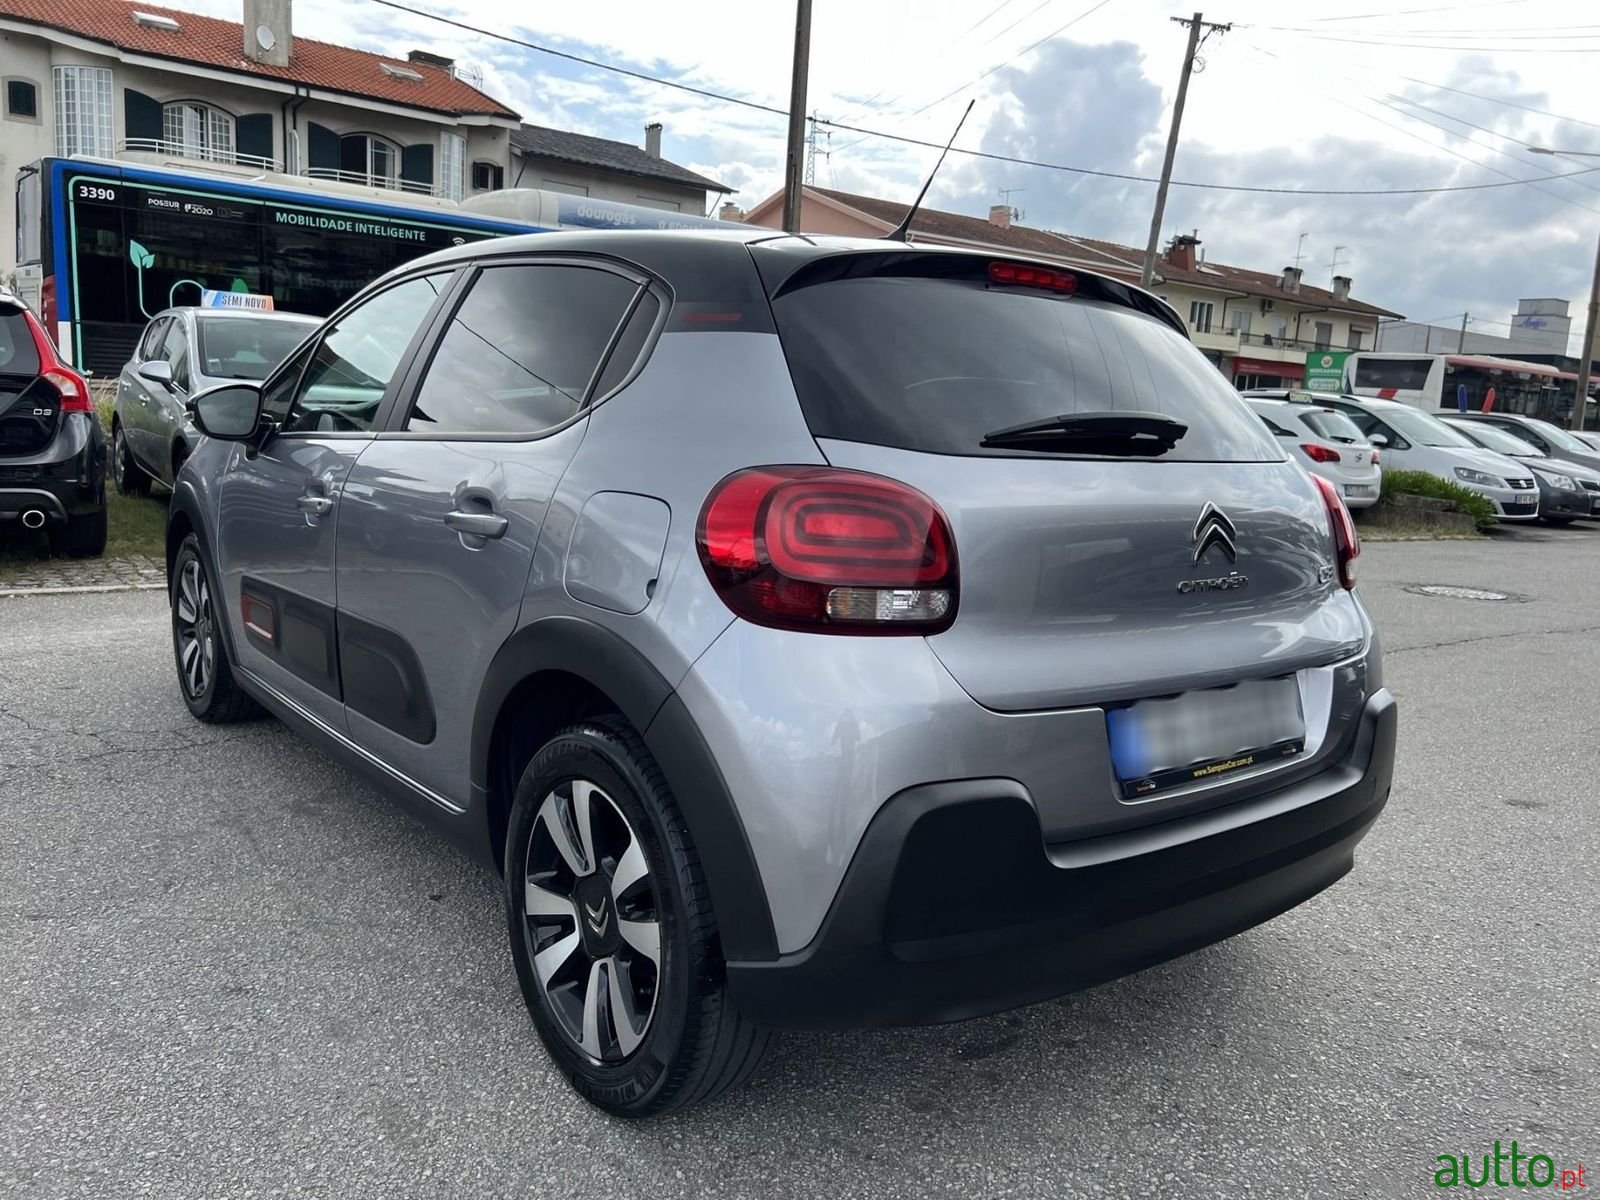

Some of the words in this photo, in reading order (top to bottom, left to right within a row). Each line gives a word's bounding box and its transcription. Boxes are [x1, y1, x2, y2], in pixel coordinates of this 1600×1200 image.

[80, 186, 115, 201] 3390
[148, 198, 180, 208] POSEUR
[191, 206, 214, 216] 2020
[275, 211, 353, 232] MOBILIDADE
[355, 222, 426, 241] INTELIGENTE
[222, 295, 242, 307] SEMI
[245, 297, 267, 309] NOVO
[33, 408, 52, 416] D3
